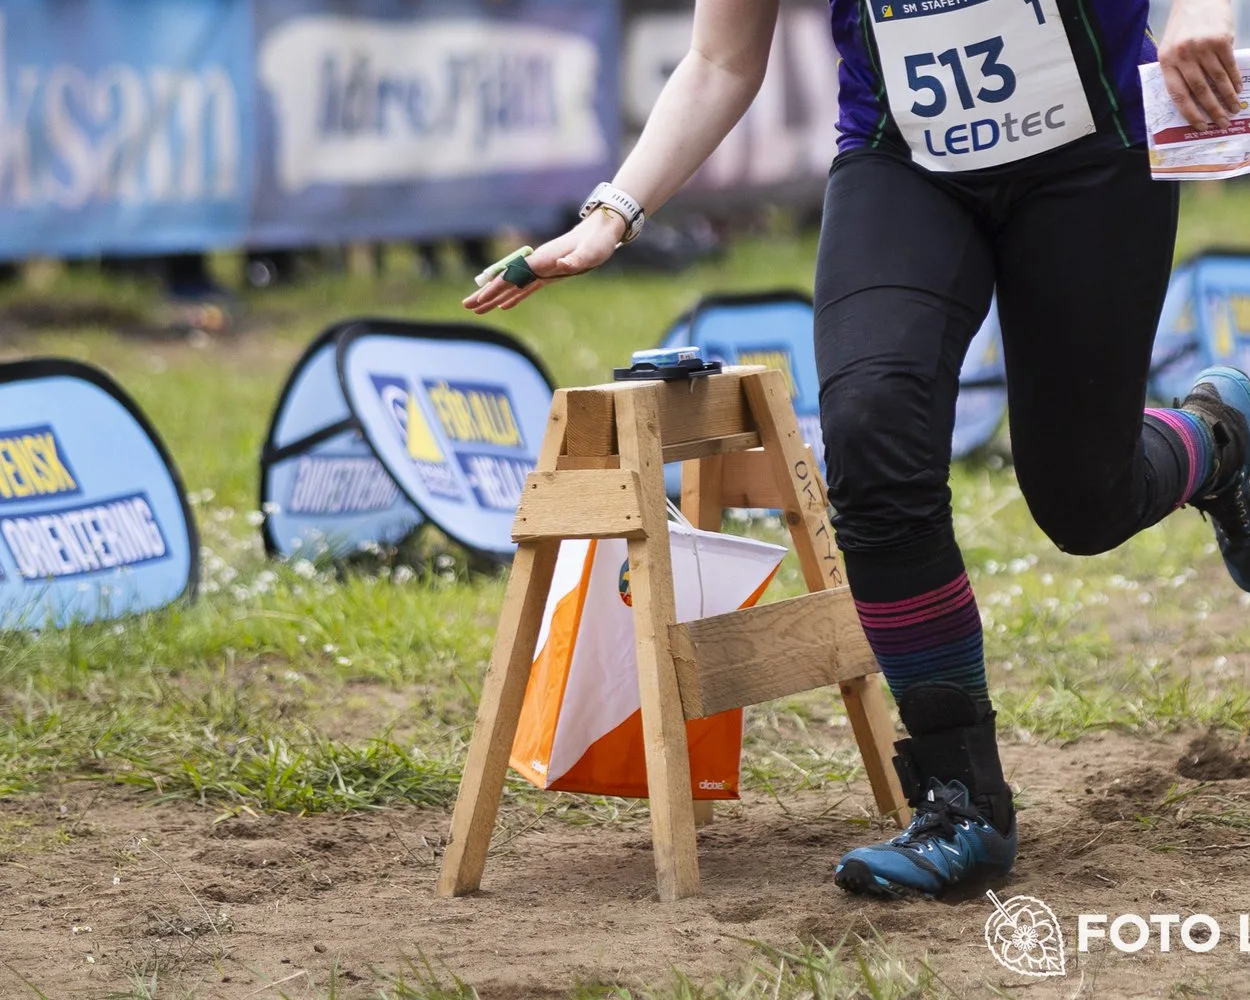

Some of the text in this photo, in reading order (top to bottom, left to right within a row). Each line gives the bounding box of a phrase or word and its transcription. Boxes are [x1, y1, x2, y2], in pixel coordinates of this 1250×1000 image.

[903, 2, 918, 14] SM
[904, 35, 1016, 118] 513
[924, 103, 1066, 157] LEDtec
[1, 496, 166, 579] ORIENTERING
